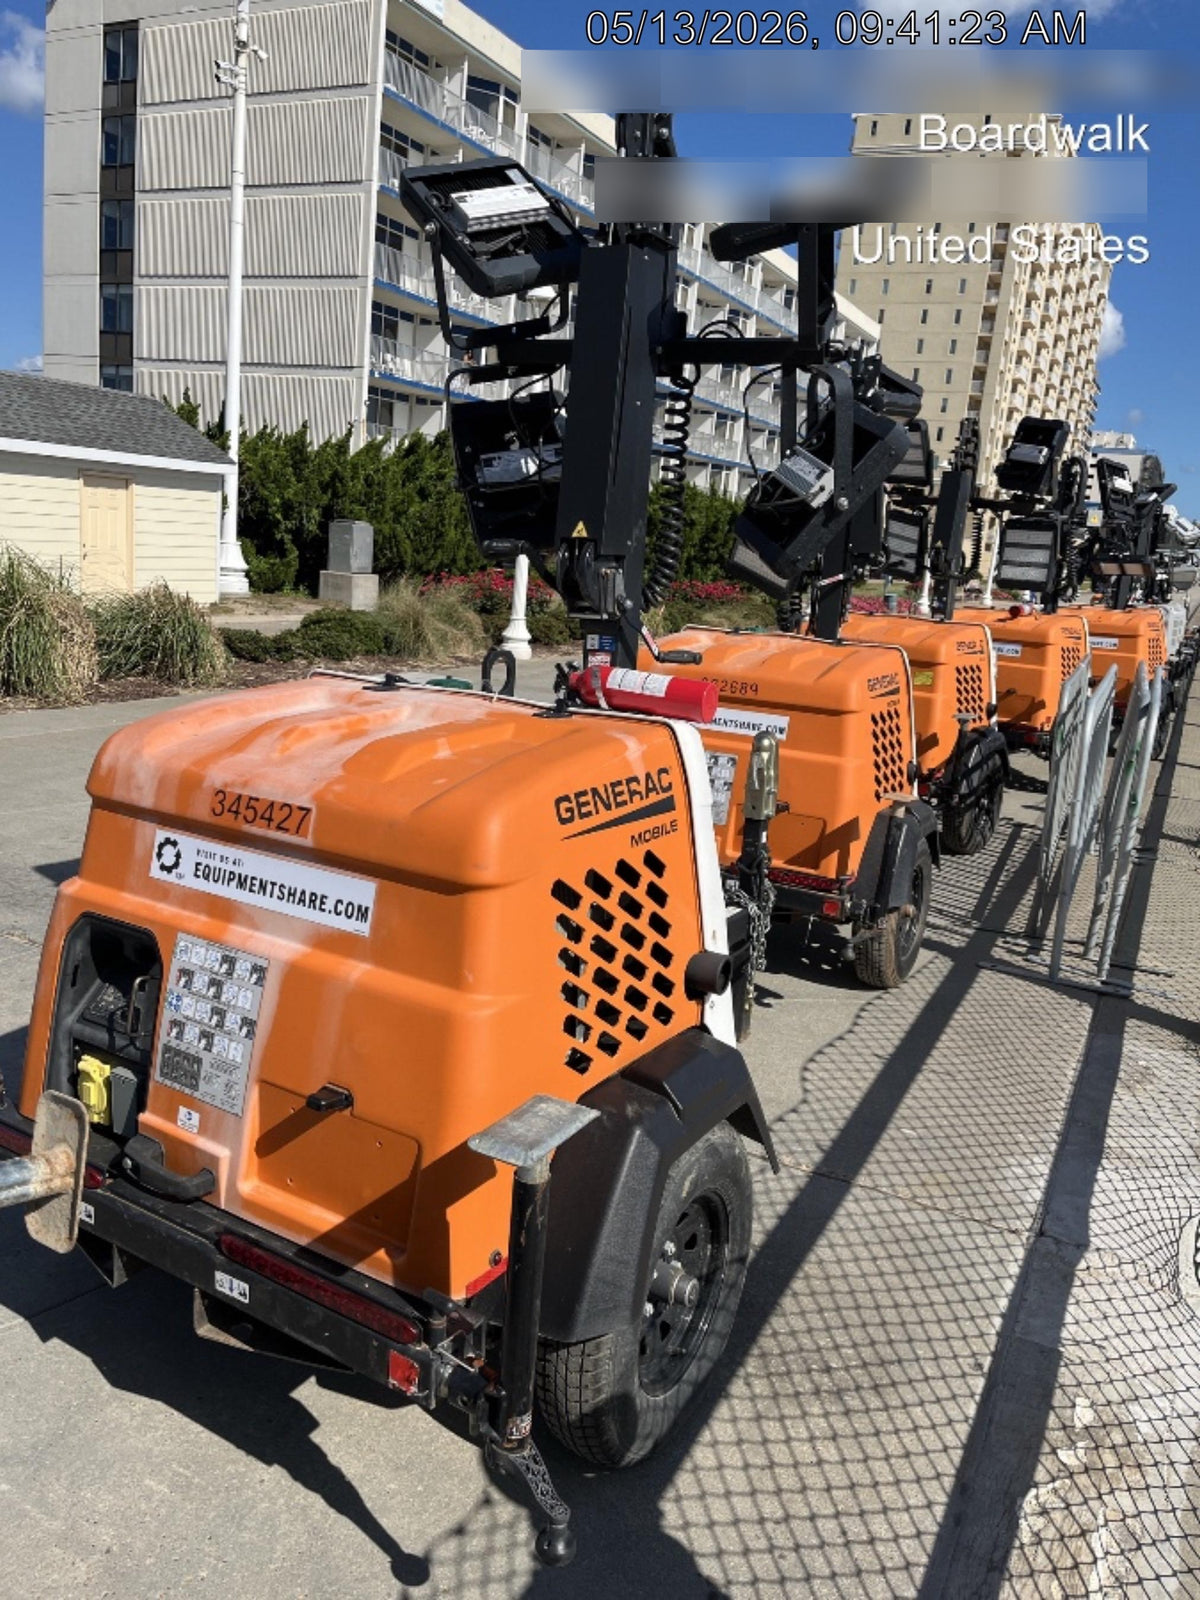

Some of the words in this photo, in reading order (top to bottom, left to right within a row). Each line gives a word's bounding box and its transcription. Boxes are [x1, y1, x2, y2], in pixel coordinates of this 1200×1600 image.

[702, 677, 758, 695] 2689
[211, 789, 312, 835] 345427
[554, 767, 674, 825] GENERAC
[630, 819, 679, 848] MOBILE
[193, 861, 369, 924] EQUIPMENTSHARE.COM
